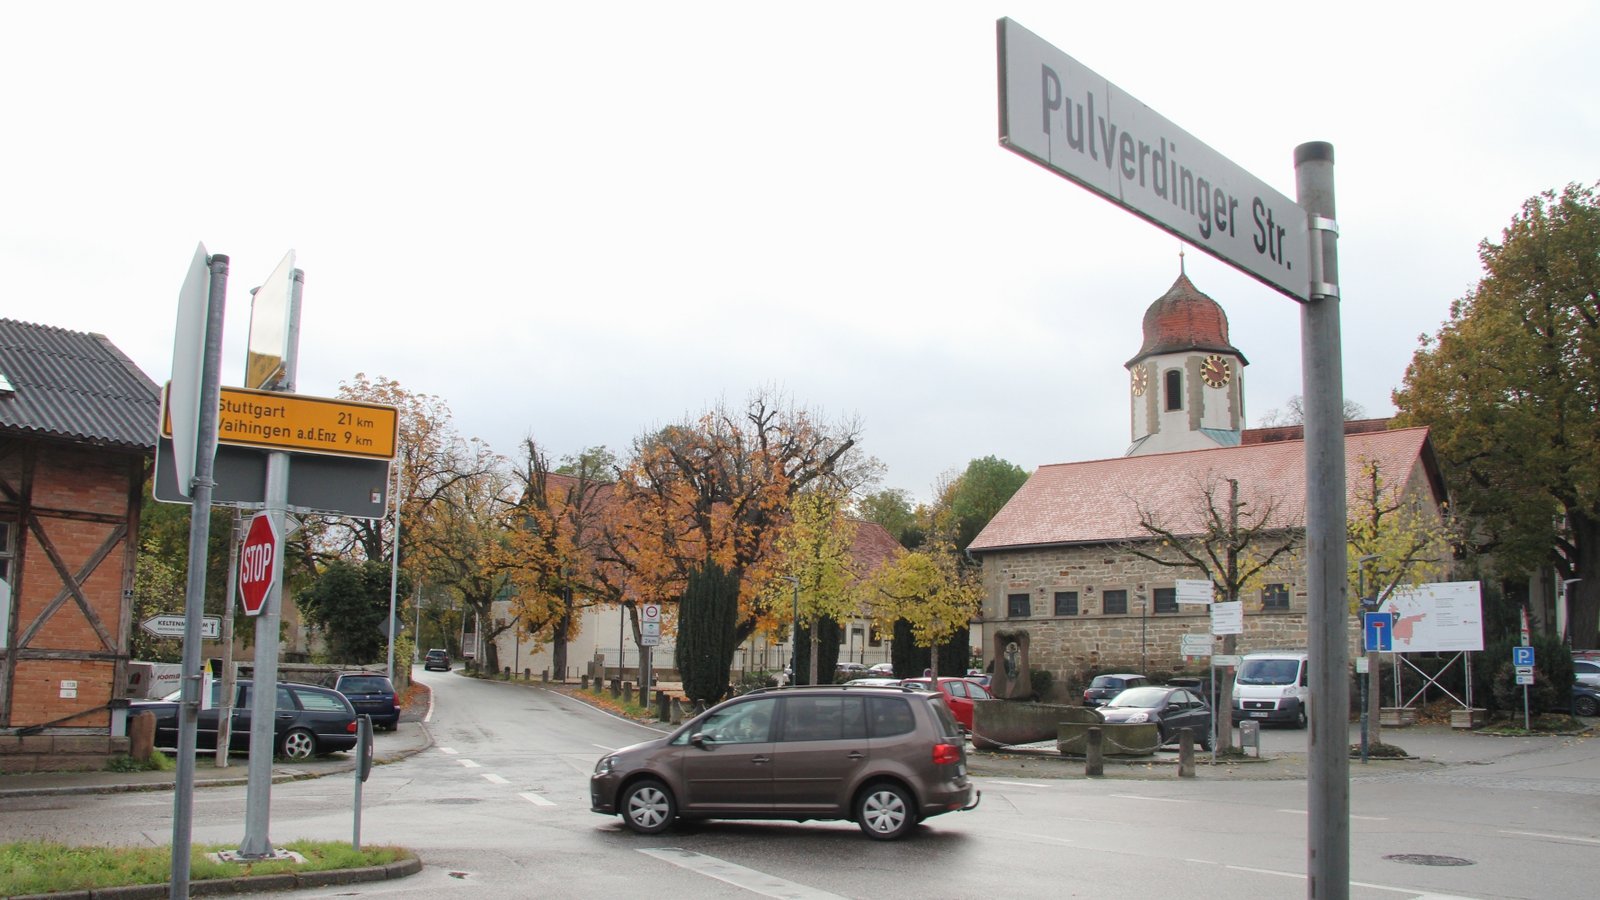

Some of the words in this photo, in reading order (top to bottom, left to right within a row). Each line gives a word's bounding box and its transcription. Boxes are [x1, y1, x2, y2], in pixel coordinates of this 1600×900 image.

[1041, 63, 1238, 240] Pulverdinger
[1252, 196, 1291, 271] Str.
[219, 398, 286, 419] Stuttgart
[337, 412, 352, 425] 21
[357, 417, 374, 429] km
[344, 431, 352, 444] 9
[355, 436, 373, 447] km
[243, 542, 272, 584] STOP
[1517, 649, 1530, 664] P
